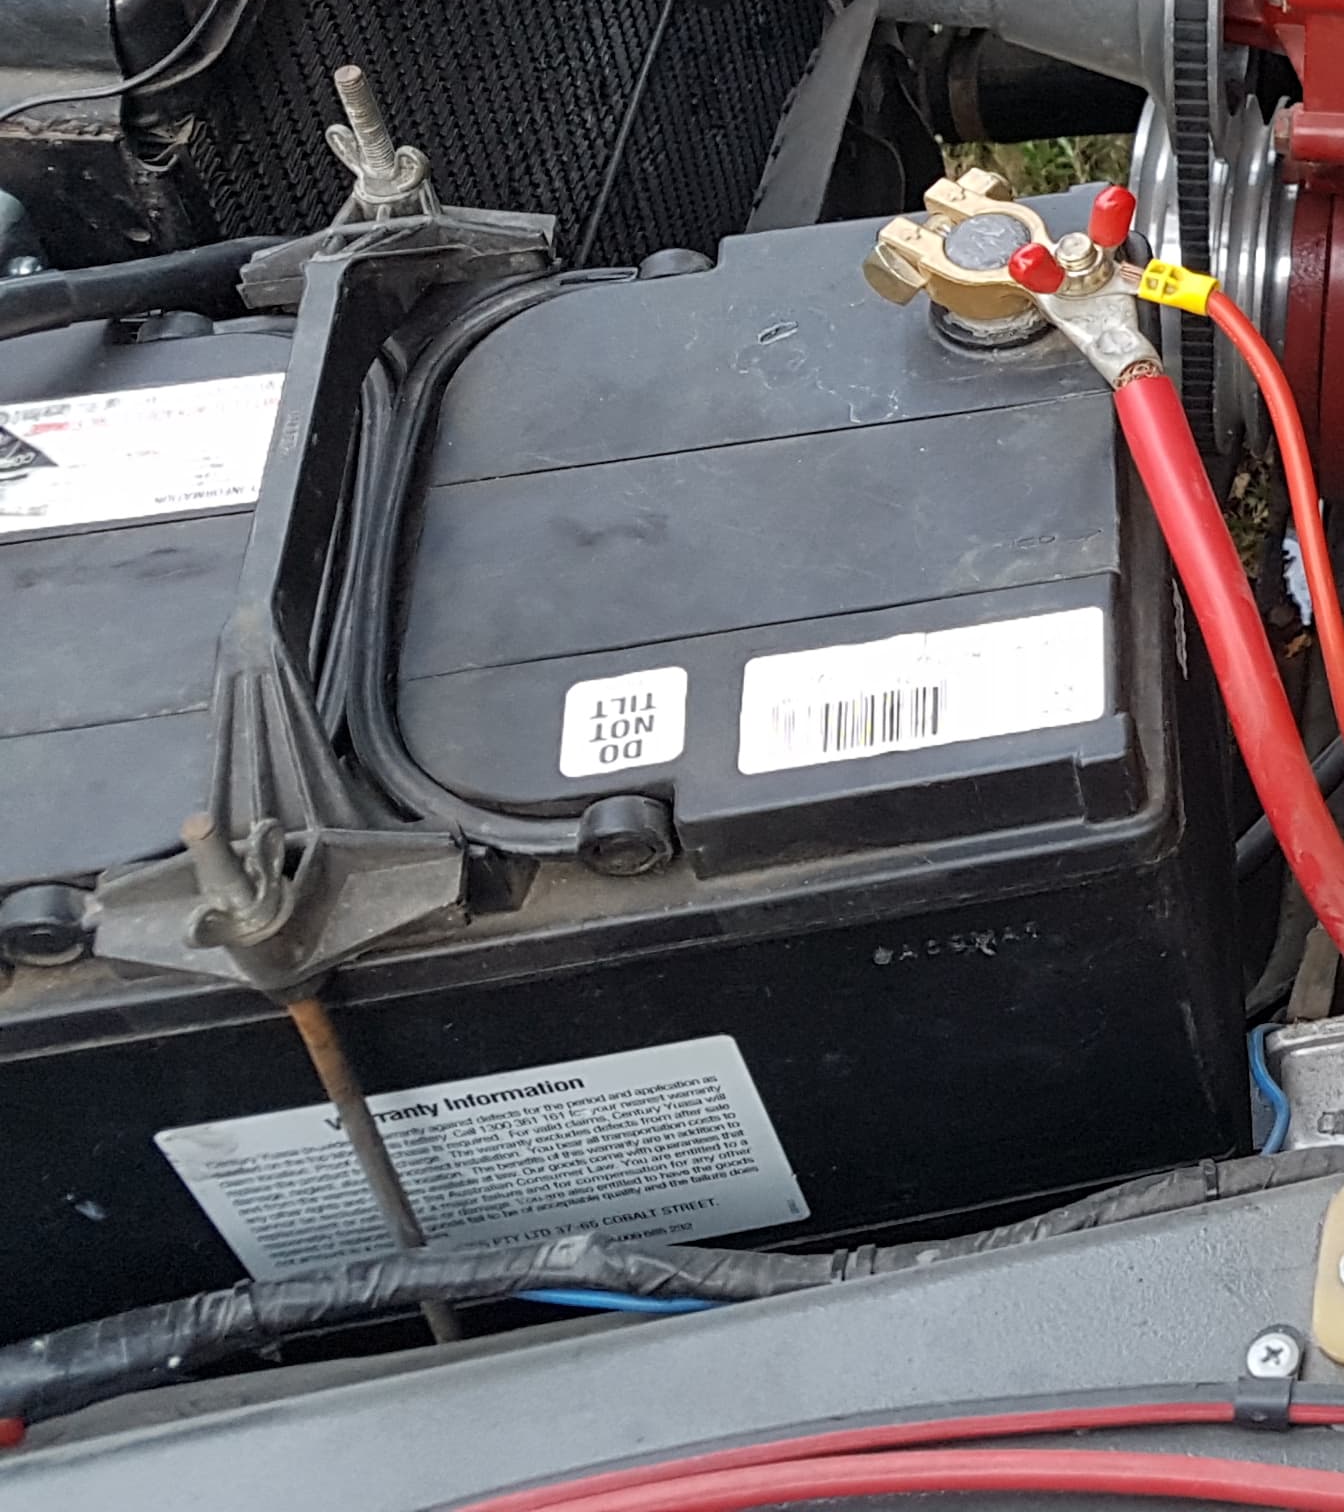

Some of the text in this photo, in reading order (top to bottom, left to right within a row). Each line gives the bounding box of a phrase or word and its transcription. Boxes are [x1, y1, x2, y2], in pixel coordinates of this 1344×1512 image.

[589, 692, 656, 720] TILT
[589, 715, 655, 743] NOT
[599, 738, 642, 764] DO
[443, 1076, 586, 1112] Information
[476, 1108, 520, 1124] defects
[523, 1105, 539, 1116] for
[543, 1101, 562, 1112] the
[566, 1093, 606, 1111] period
[609, 1088, 631, 1101] and
[634, 1077, 700, 1097] application
[702, 1075, 718, 1084] as
[479, 1119, 511, 1133] 1300
[513, 1114, 537, 1127] 361
[542, 1109, 565, 1122] 161
[592, 1103, 615, 1116] your
[666, 1083, 720, 1101] warranty
[508, 1127, 528, 1138] For
[533, 1120, 561, 1134] valid
[611, 1103, 660, 1121] Century
[662, 1096, 702, 1111] Yuasa
[704, 1091, 726, 1103] will
[450, 1146, 473, 1158] The
[477, 1136, 532, 1155] warranty
[535, 1125, 591, 1143] excludes
[593, 1117, 638, 1133] defects
[640, 1111, 671, 1125] from
[675, 1106, 701, 1119] after
[704, 1101, 730, 1113] sale
[471, 1162, 493, 1174] The
[547, 1150, 559, 1161] of
[561, 1146, 584, 1158] this
[586, 1136, 640, 1155] warranty
[642, 1134, 661, 1144] are
[662, 1130, 675, 1140] in
[678, 1121, 725, 1137] addition
[727, 1119, 740, 1129] to
[522, 1163, 544, 1175] Our
[547, 1156, 587, 1173] goods
[589, 1151, 623, 1163] come
[626, 1144, 652, 1157] with
[653, 1132, 720, 1154] guarantees
[721, 1127, 744, 1140] that
[529, 1142, 553, 1154] You
[586, 1133, 600, 1144] all
[602, 1118, 686, 1142] transportation
[688, 1112, 720, 1126] costs
[722, 1109, 736, 1120] to
[516, 1166, 583, 1186] Consumer
[620, 1154, 648, 1167] You
[651, 1152, 671, 1162] are
[674, 1141, 720, 1158] entitled
[723, 1139, 737, 1149] to
[739, 1138, 748, 1146] a
[526, 1180, 551, 1193] and
[553, 1177, 571, 1189] for
[574, 1160, 667, 1186] compensation
[670, 1157, 687, 1168] for
[691, 1154, 713, 1165] any
[717, 1146, 751, 1160] other
[596, 1174, 642, 1191] entitled
[643, 1172, 657, 1183] to
[658, 1166, 690, 1180] have
[691, 1162, 712, 1174] the
[714, 1155, 755, 1173] goods
[643, 1179, 667, 1192] and
[668, 1176, 689, 1188] the
[729, 1164, 759, 1177] does
[601, 1207, 657, 1226] COBALT
[660, 1197, 720, 1216] STREET.
